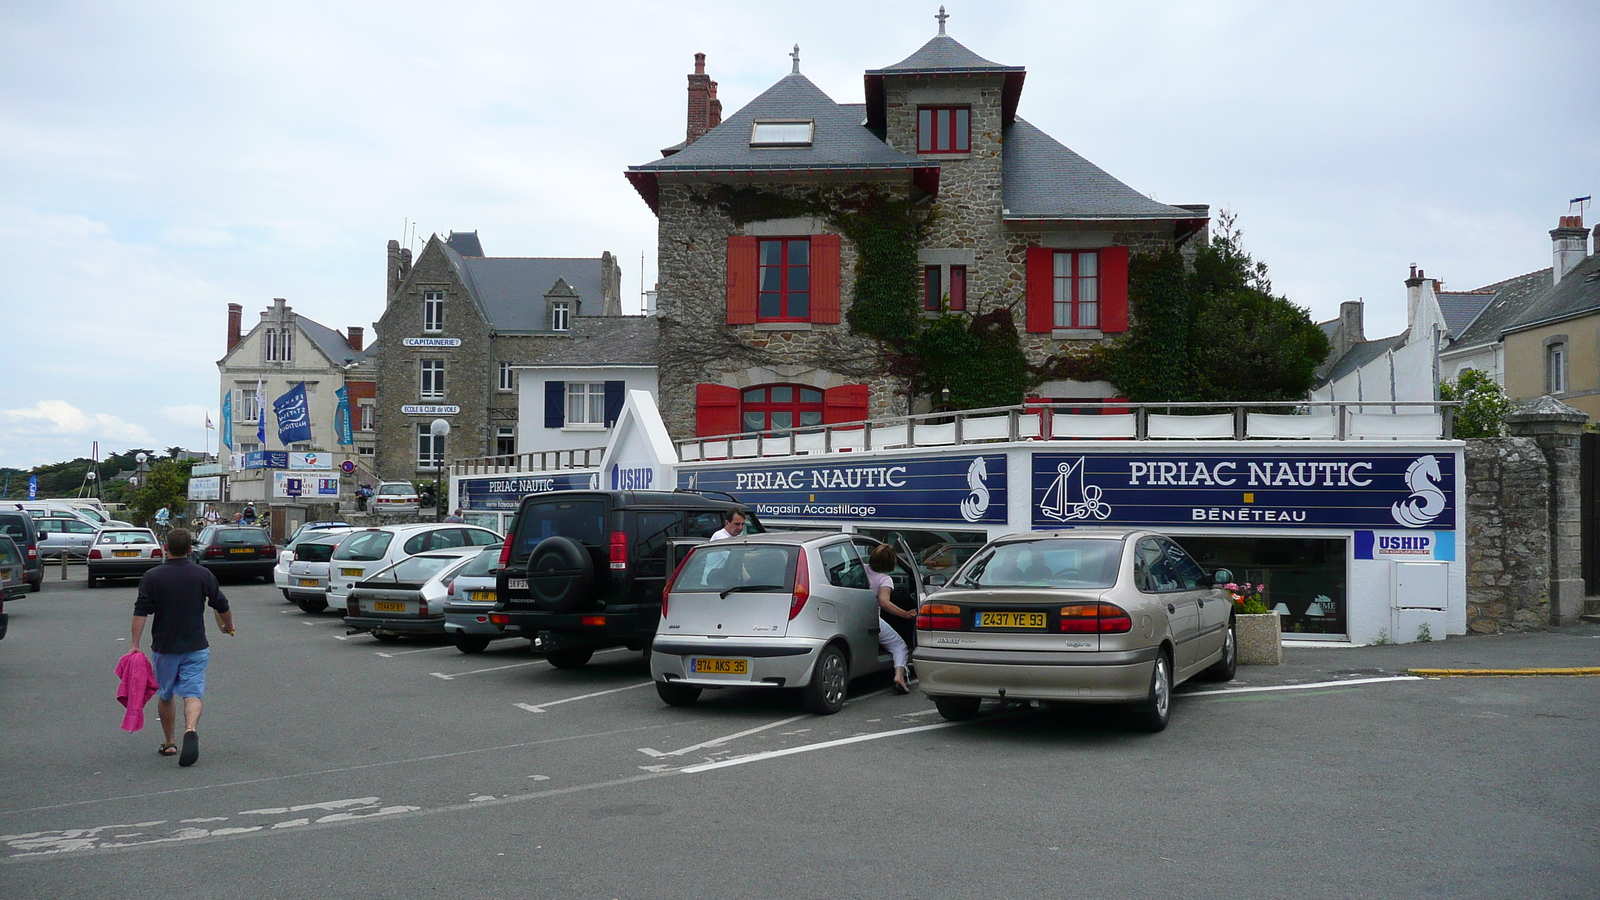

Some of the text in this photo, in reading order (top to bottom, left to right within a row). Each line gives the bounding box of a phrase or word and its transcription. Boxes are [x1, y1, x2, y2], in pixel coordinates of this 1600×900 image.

[620, 467, 653, 490] USHIP
[736, 467, 907, 490] PIRIAC NAUTIC
[1129, 462, 1372, 486] PIRIAC NAUTIC
[489, 479, 554, 492] PIRIAC NAUTIC
[756, 504, 876, 516] Magasin Accastillage
[1379, 536, 1430, 550] USHIP
[983, 613, 1009, 625] 2437
[1013, 614, 1026, 625] YE
[1029, 614, 1044, 626] 93
[697, 660, 744, 672] 974 AKS 35
